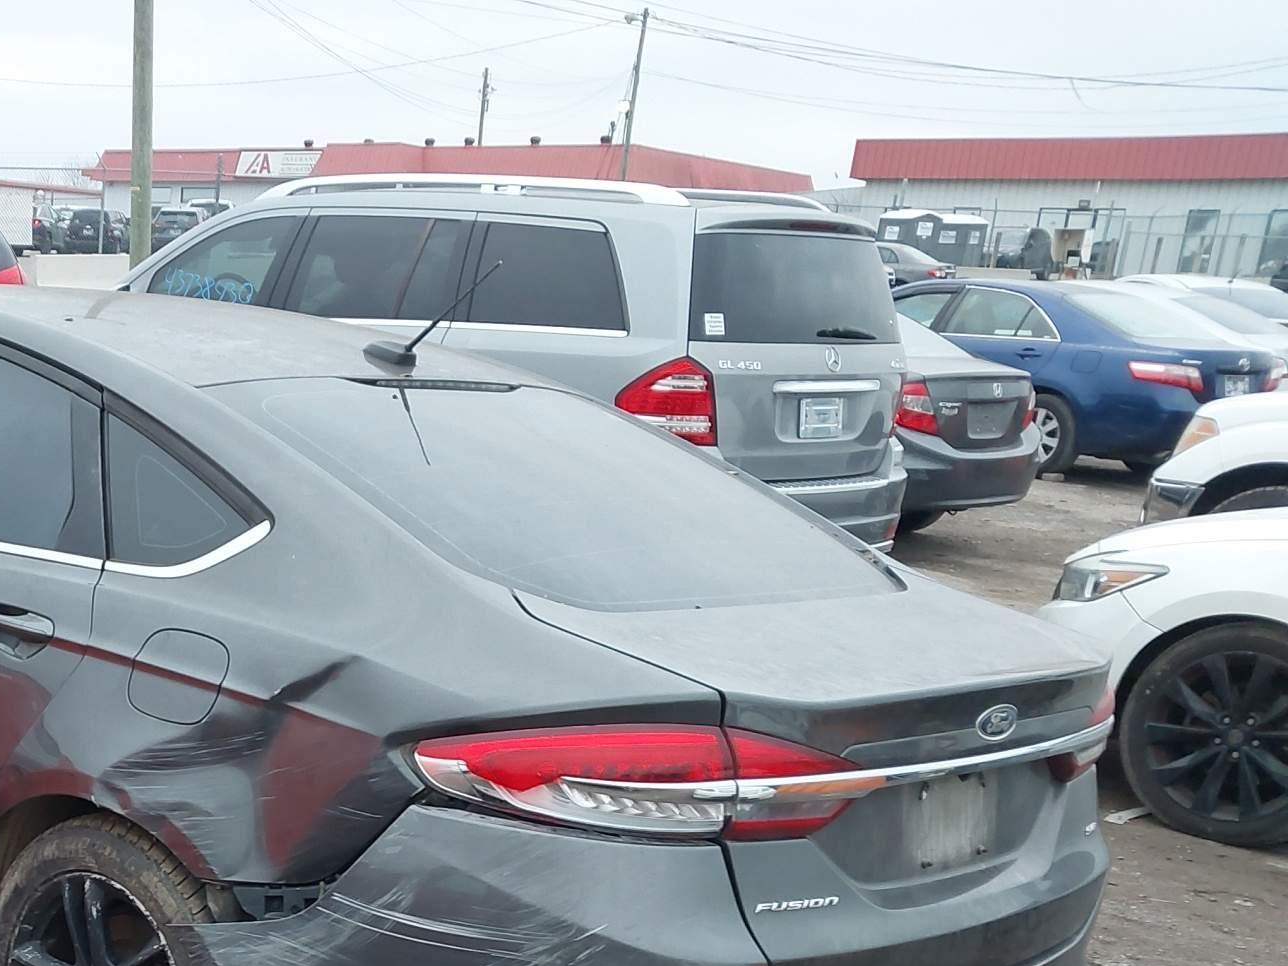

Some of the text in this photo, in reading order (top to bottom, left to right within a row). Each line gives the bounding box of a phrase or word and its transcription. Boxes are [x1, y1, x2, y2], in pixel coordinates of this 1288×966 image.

[718, 360, 761, 370] GL 450
[754, 896, 840, 913] FUSION
